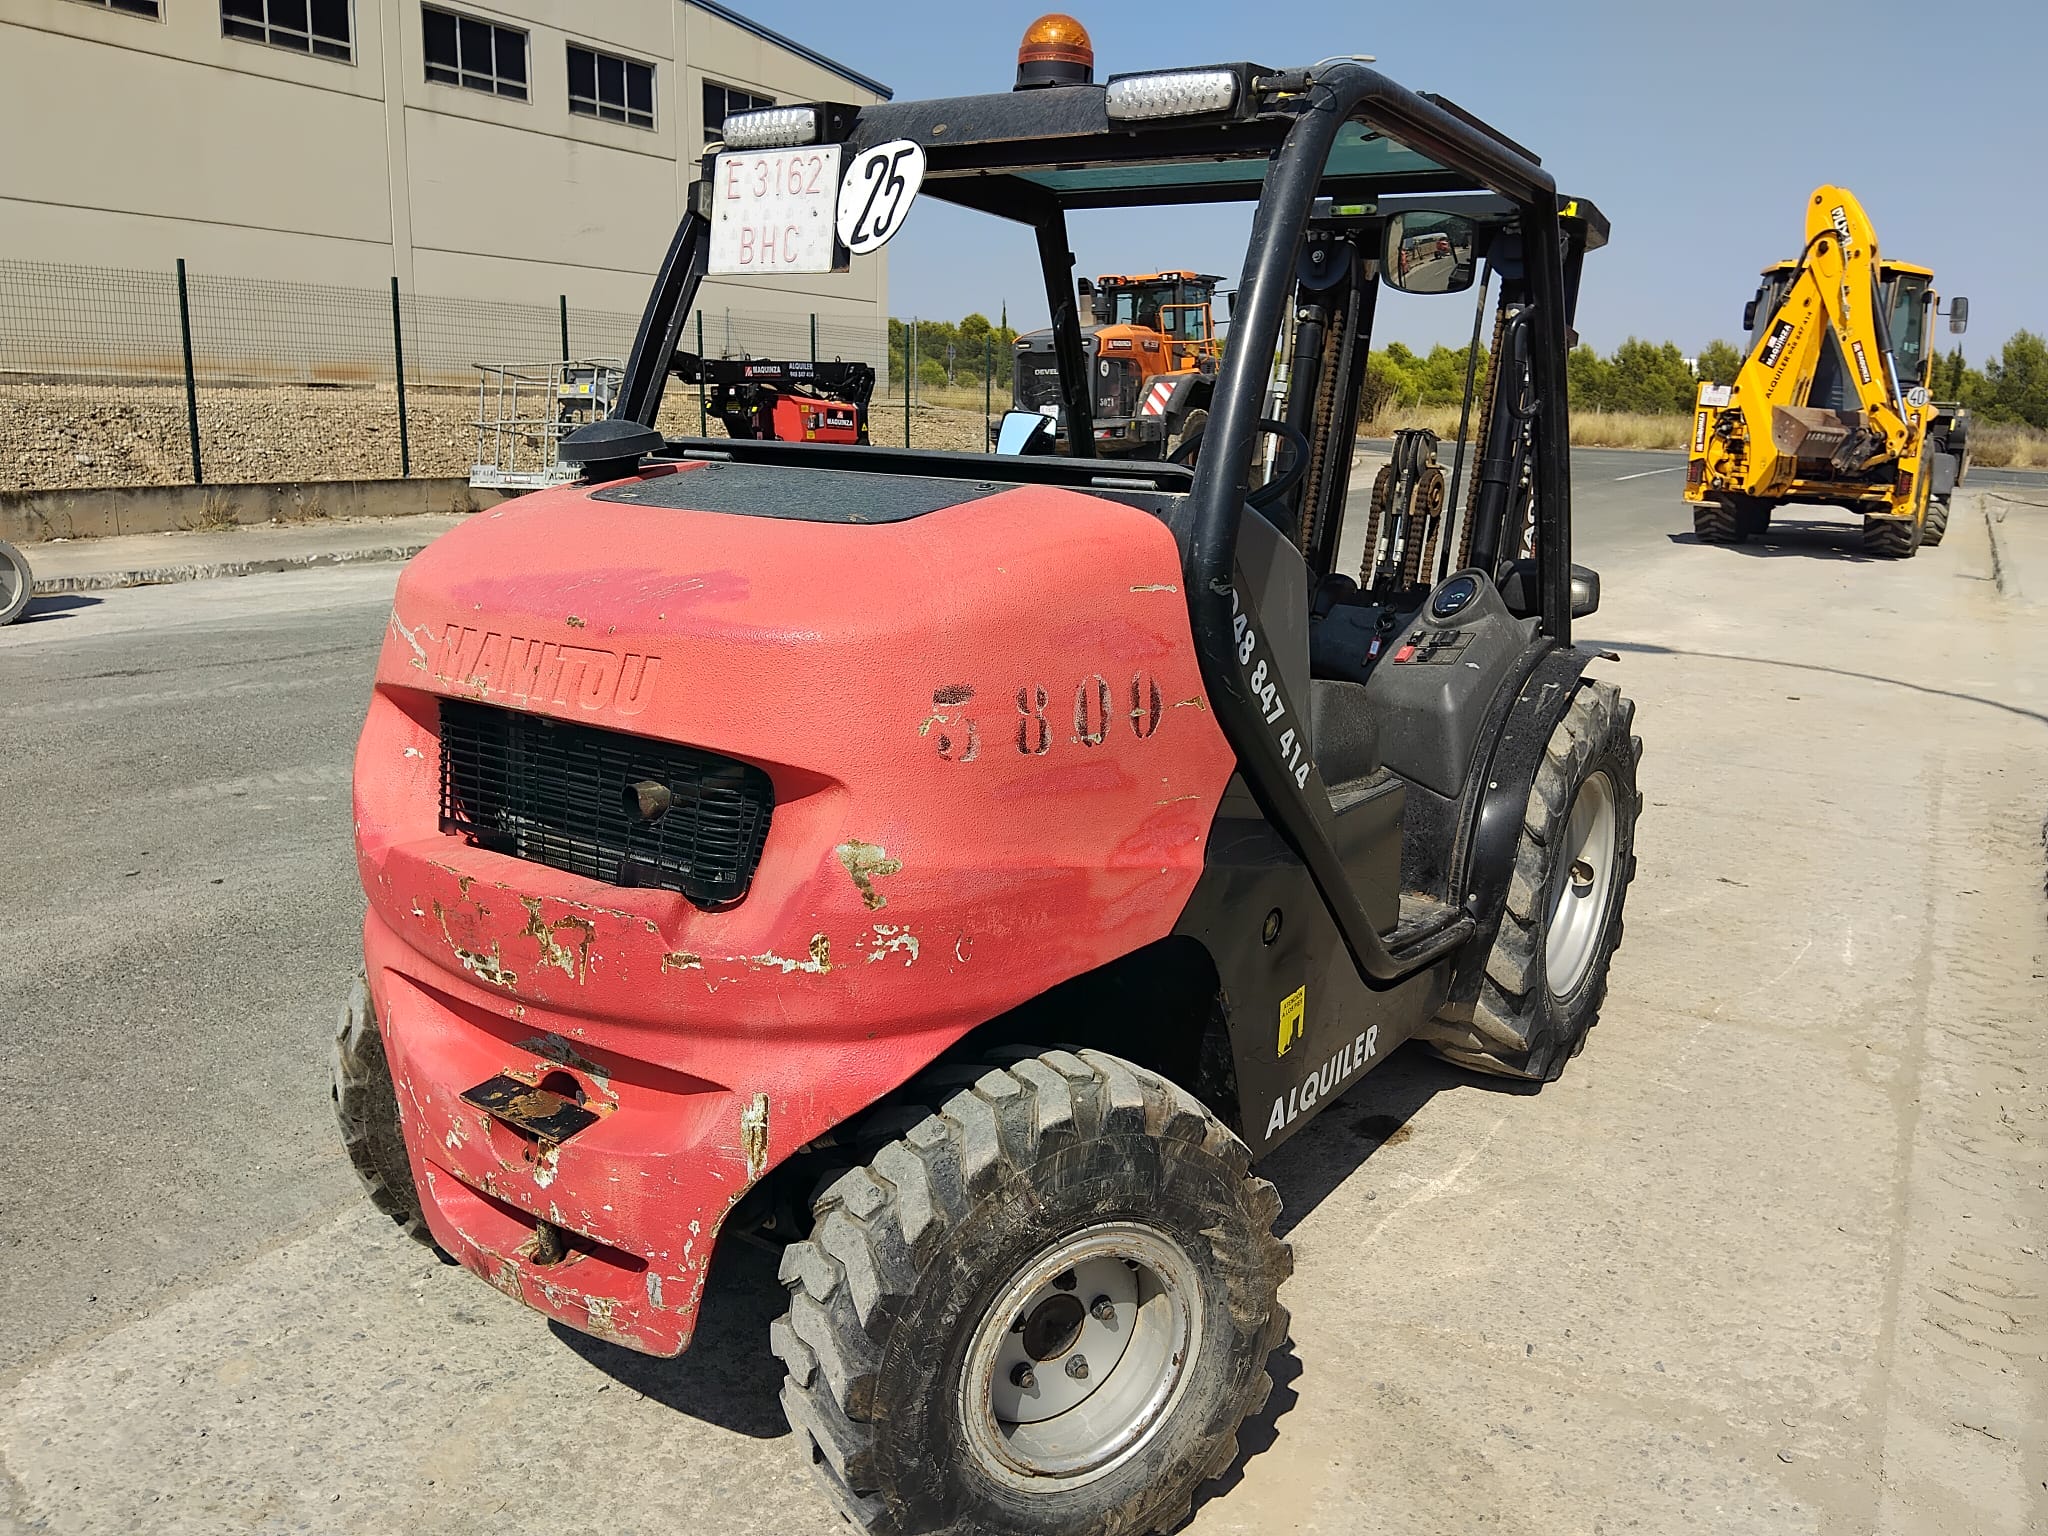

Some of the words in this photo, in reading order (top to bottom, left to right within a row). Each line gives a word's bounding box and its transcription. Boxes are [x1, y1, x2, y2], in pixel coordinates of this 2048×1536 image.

[727, 160, 744, 200] E
[753, 155, 824, 198] 3162
[850, 146, 915, 245] 25
[739, 224, 800, 265] BHC
[1765, 324, 1792, 367] MAQUINZA
[752, 366, 781, 374] MAQUINZA
[1765, 355, 1790, 399] ALQUILER
[1910, 389, 1926, 405] 40
[434, 623, 661, 715] MANITOU
[1250, 659, 1286, 725] 847
[1279, 727, 1311, 790] 414
[1264, 1024, 1378, 1141] ALQUILER
